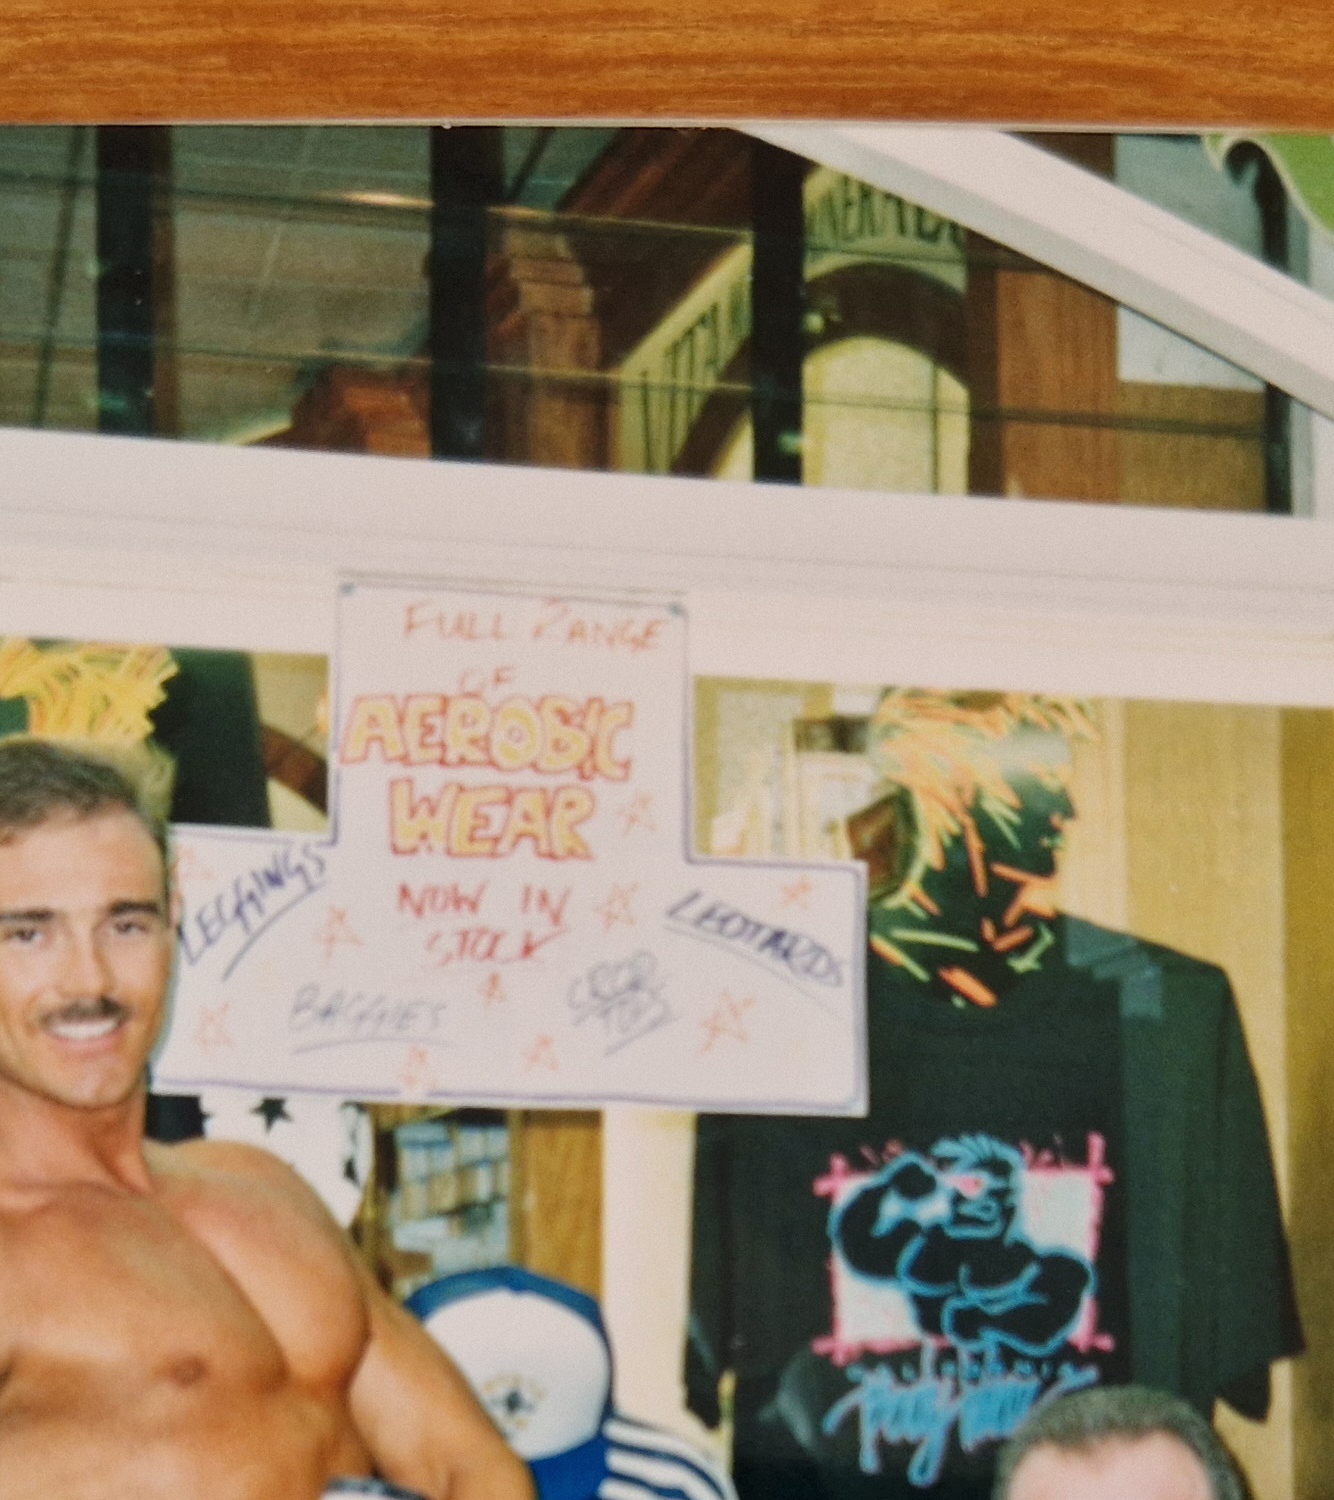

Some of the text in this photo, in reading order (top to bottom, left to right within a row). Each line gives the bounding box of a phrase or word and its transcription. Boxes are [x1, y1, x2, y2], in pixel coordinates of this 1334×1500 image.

[402, 597, 670, 652] FULL RANGE
[457, 665, 516, 699] OF
[338, 692, 636, 783] AEROBIC
[388, 777, 598, 861] WEAR
[174, 842, 327, 967] LEGGINGS
[396, 880, 572, 926] NOW IN
[426, 925, 571, 968] STOCK
[289, 980, 448, 1035] BAGGIES
